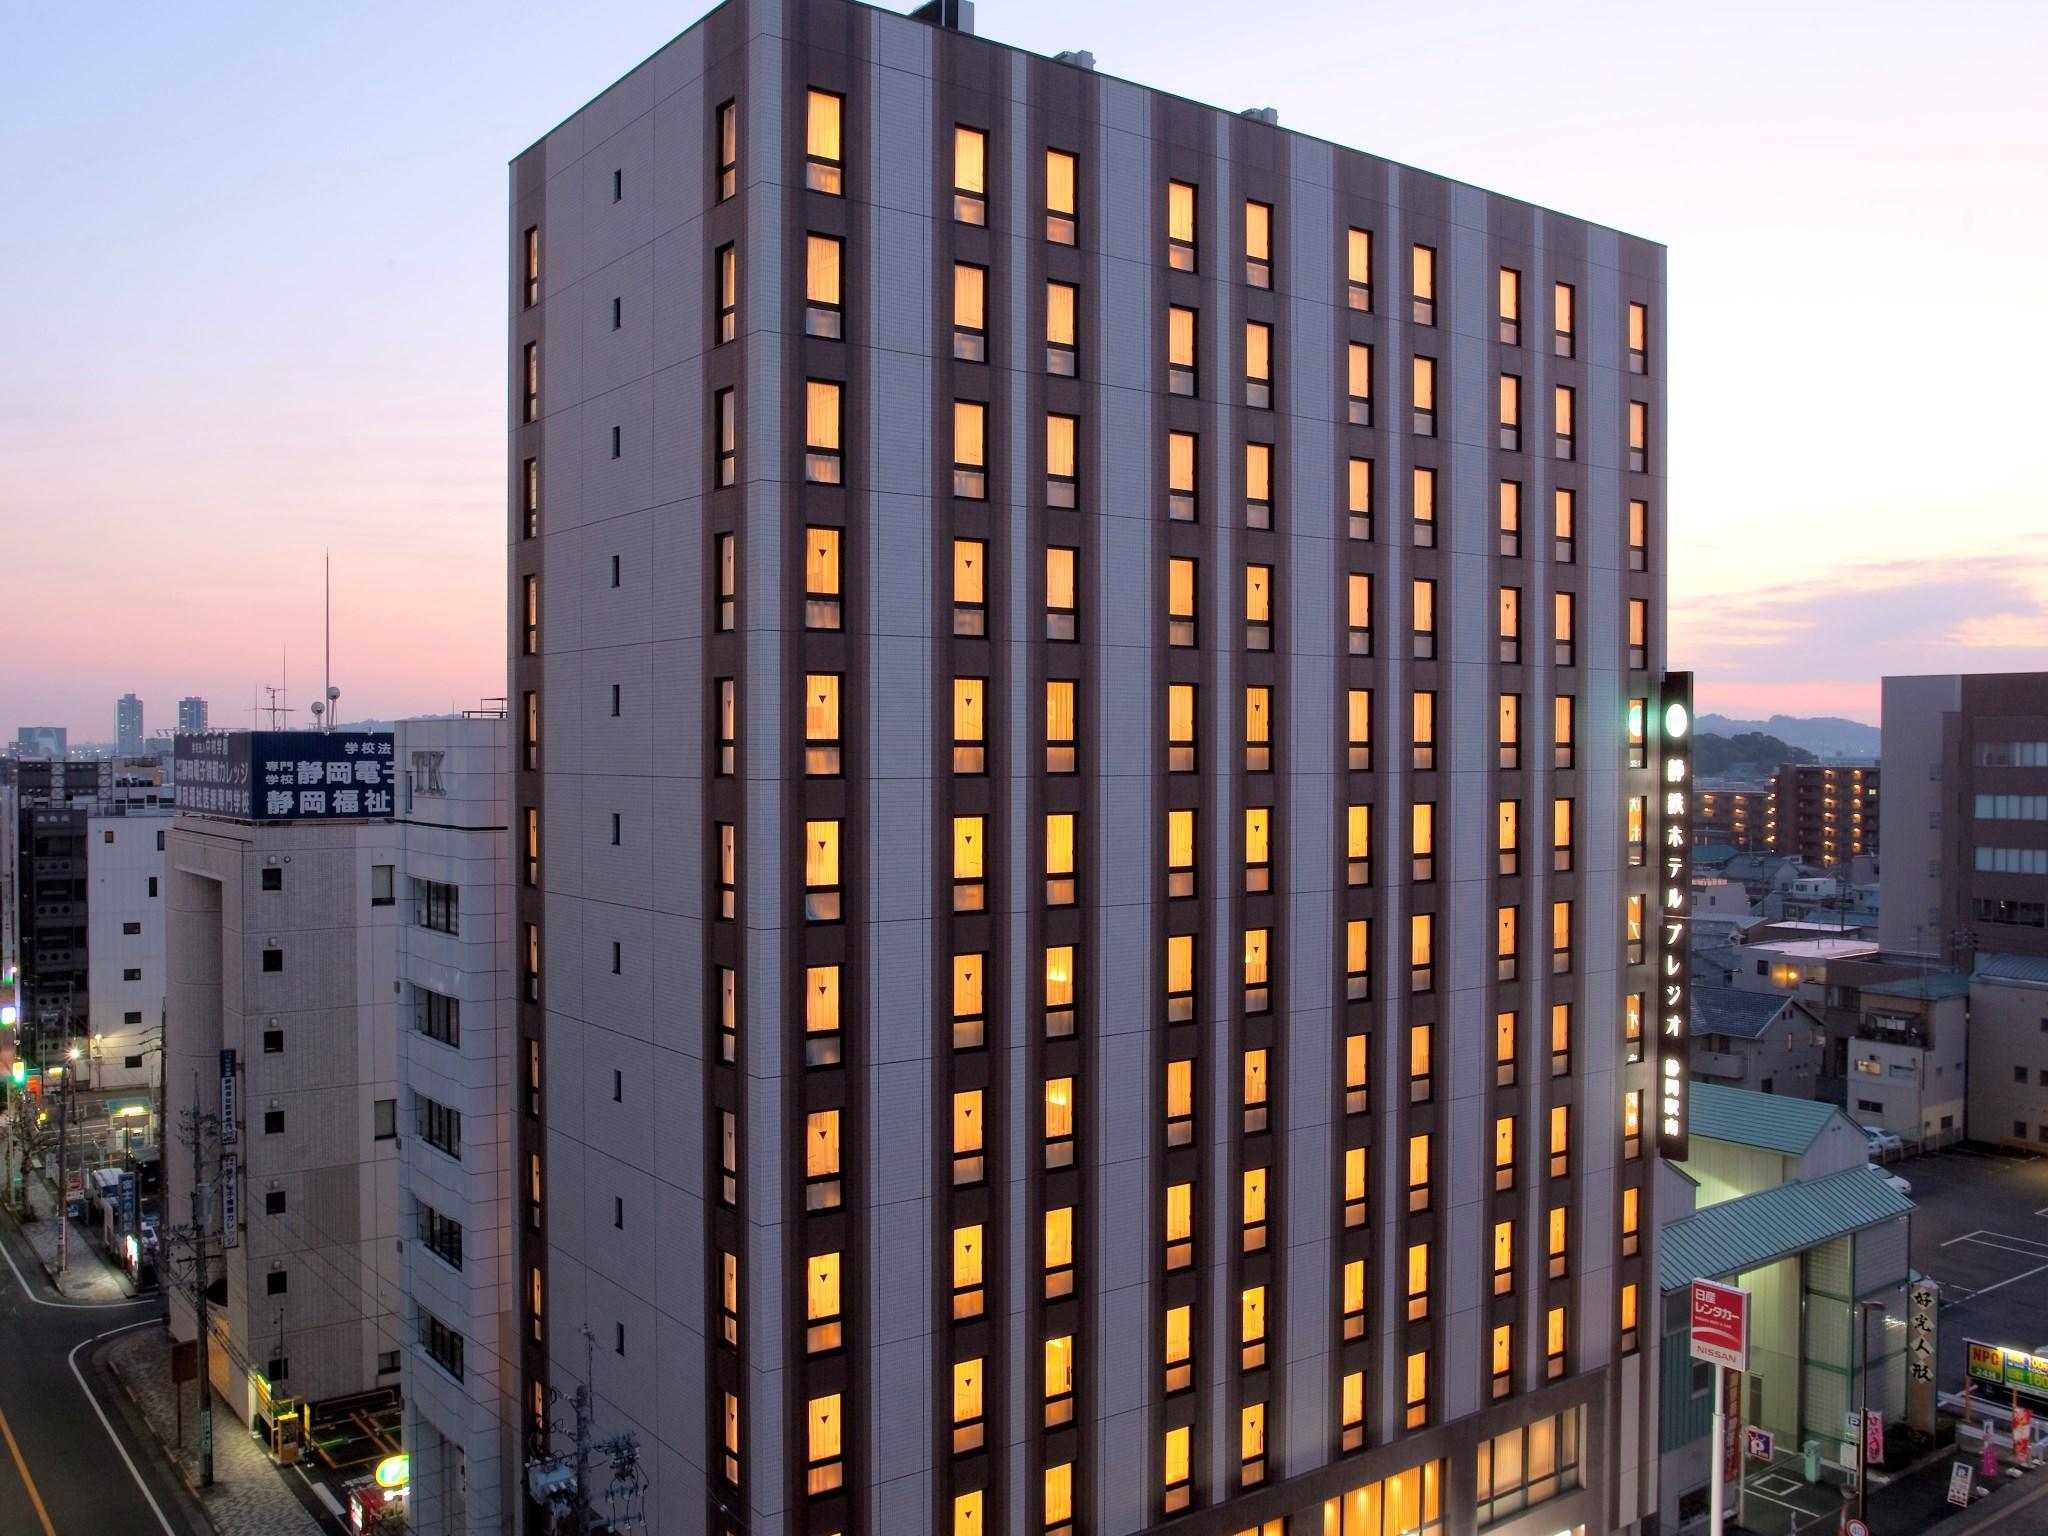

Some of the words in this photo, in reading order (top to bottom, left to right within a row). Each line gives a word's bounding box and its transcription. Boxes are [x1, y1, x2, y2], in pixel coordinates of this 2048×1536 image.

[266, 789, 391, 815] 静岡福祉
[1664, 758, 1685, 1038] 静鉄ホテルプレジオ
[1695, 1288, 1716, 1304] 日産
[1695, 1301, 1740, 1320] レンタカー
[1697, 1345, 1737, 1363] NISSAN
[1973, 1347, 2000, 1366] NPC
[1975, 1367, 1996, 1380] 24H
